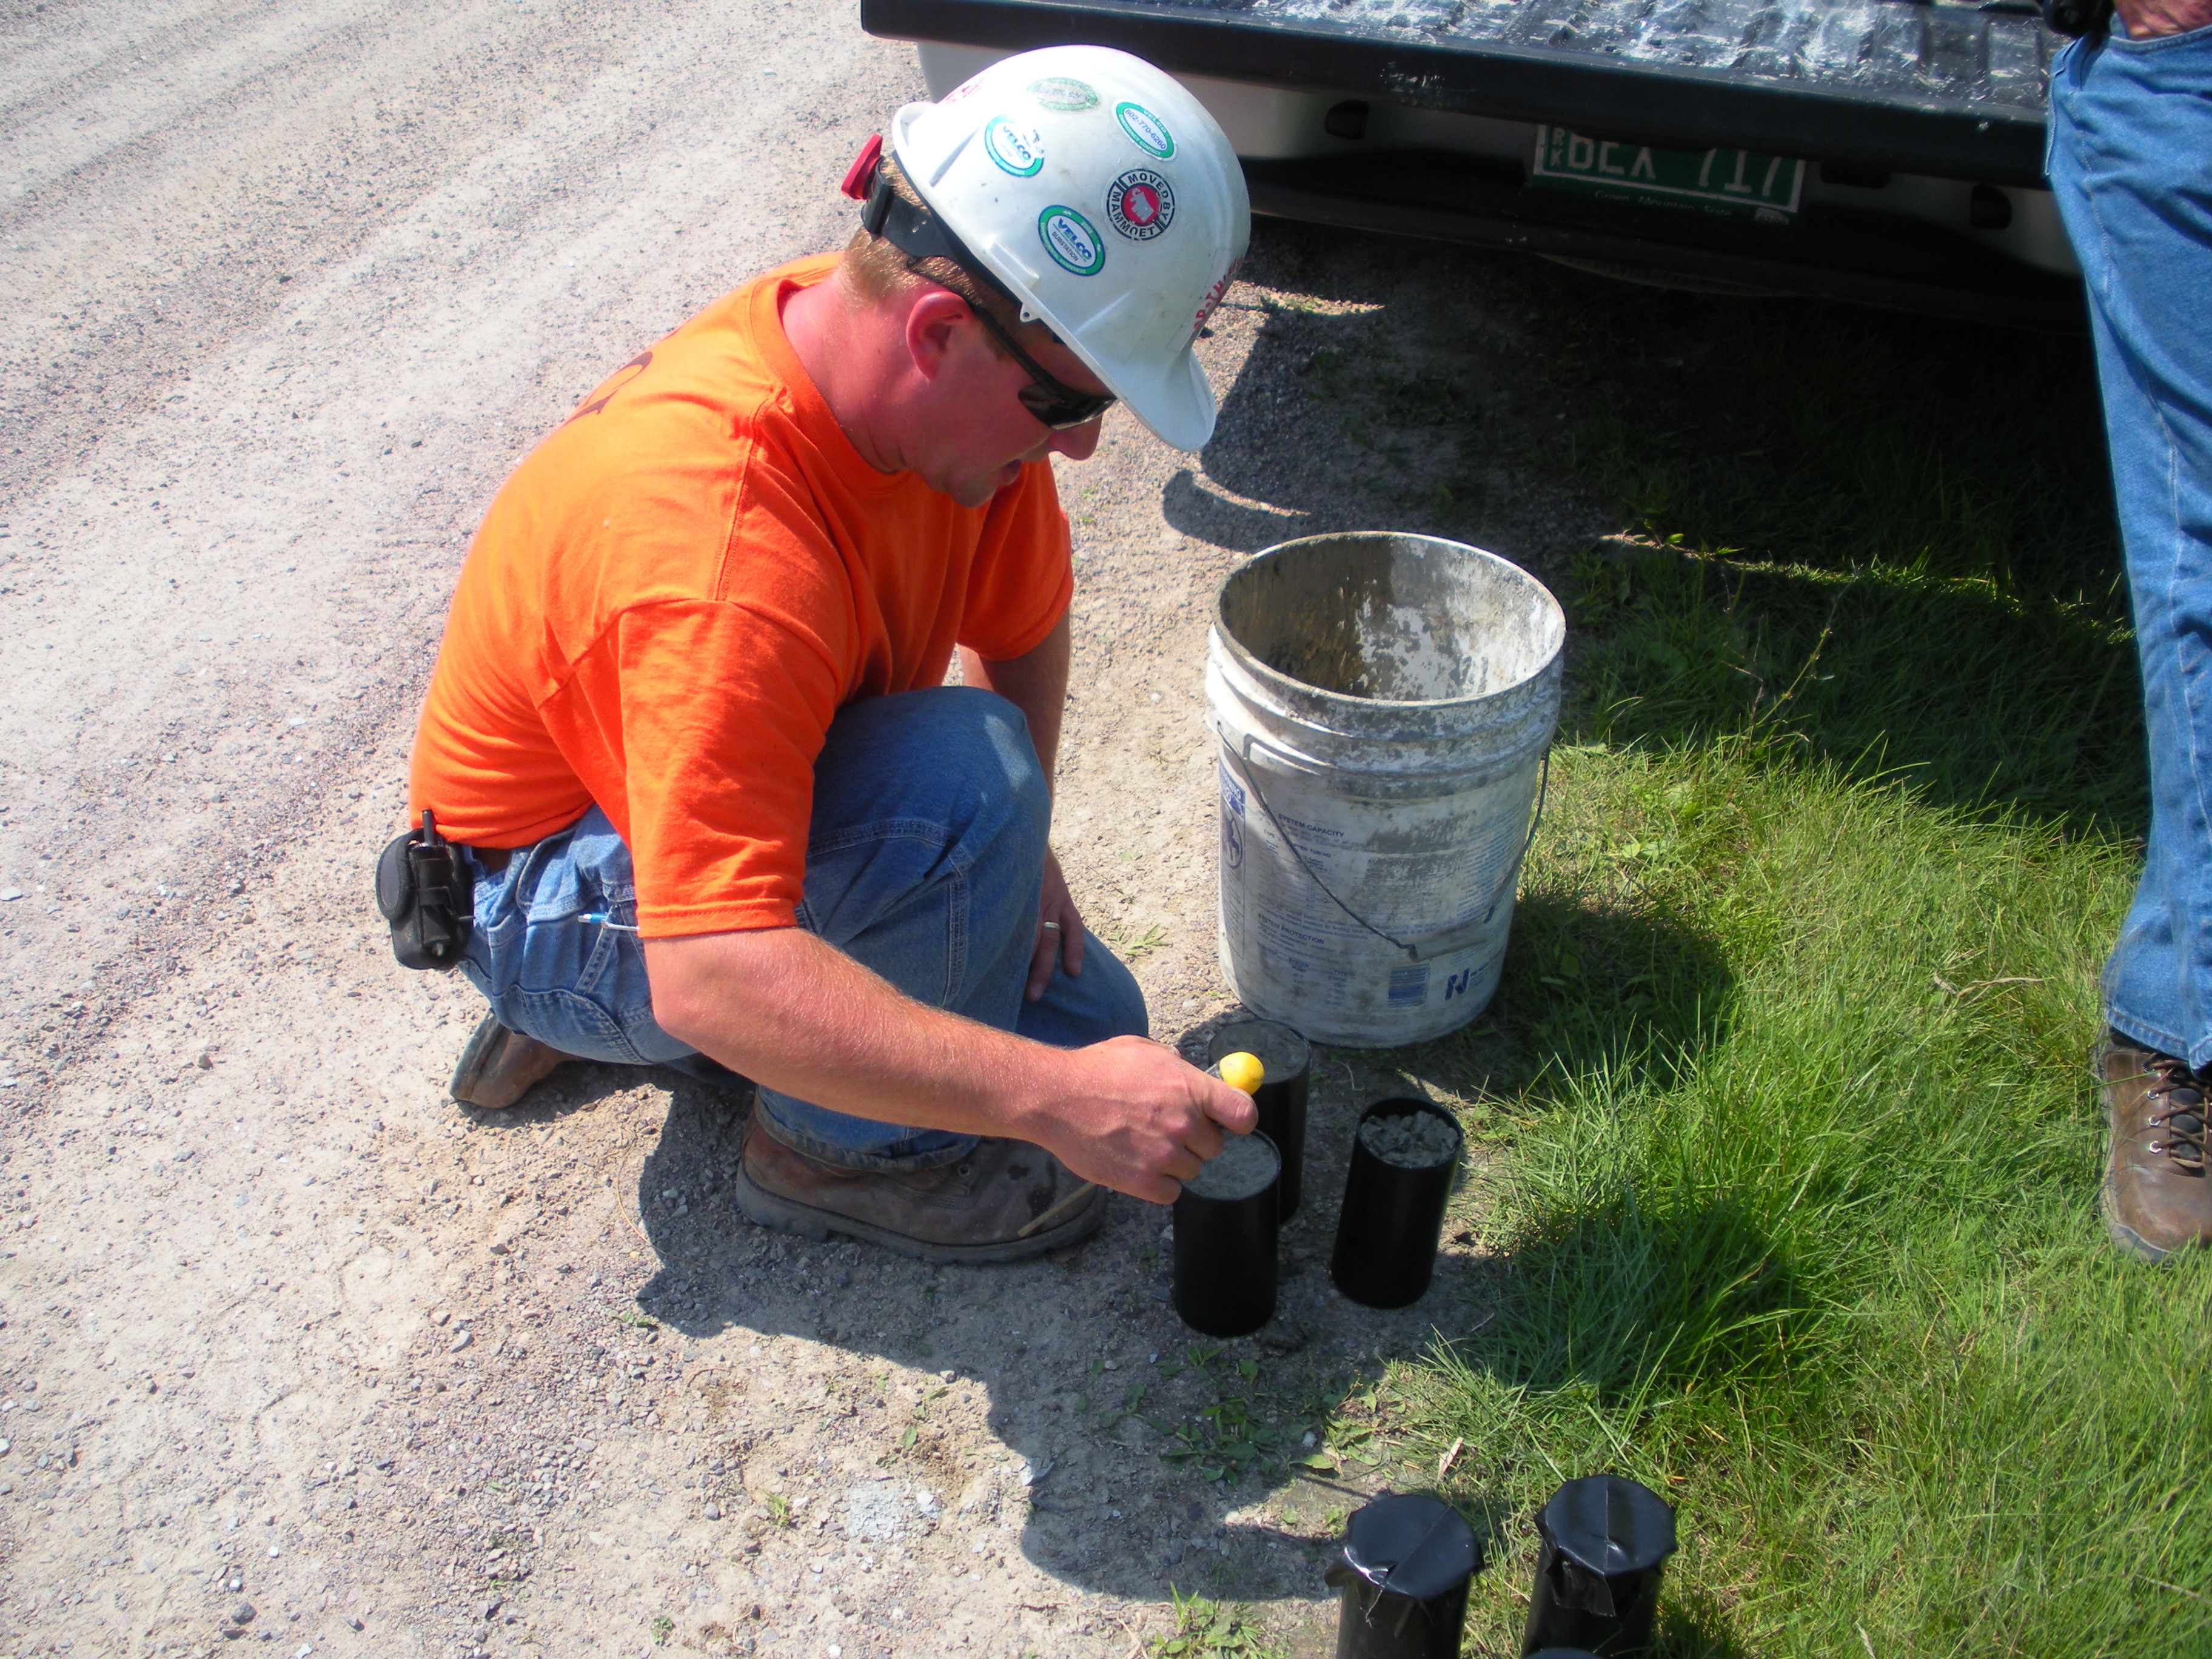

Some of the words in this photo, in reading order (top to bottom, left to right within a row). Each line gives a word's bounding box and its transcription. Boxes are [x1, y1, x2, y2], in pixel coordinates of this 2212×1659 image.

[1119, 114, 1139, 141] EMERGENCY
[1139, 141, 1161, 156] CONTACT
[1125, 109, 1167, 149] 802-770-6260
[1143, 109, 1167, 133] VELCO
[1002, 125, 1031, 161] VELCO
[1111, 191, 1155, 237] MAMMOET
[1127, 172, 1169, 199] MOVED
[1161, 202, 1171, 220] BY
[1594, 190, 1629, 201] Green
[1638, 196, 1695, 210] Mountain
[1703, 204, 1732, 216] State
[1052, 230, 1079, 261] SUBSTATION
[1057, 217, 1092, 260] VELCO
[1278, 813, 1305, 828] SYSTEM
[1307, 825, 1344, 838] CAPACITY
[1281, 925, 1324, 944] PROTECTION
